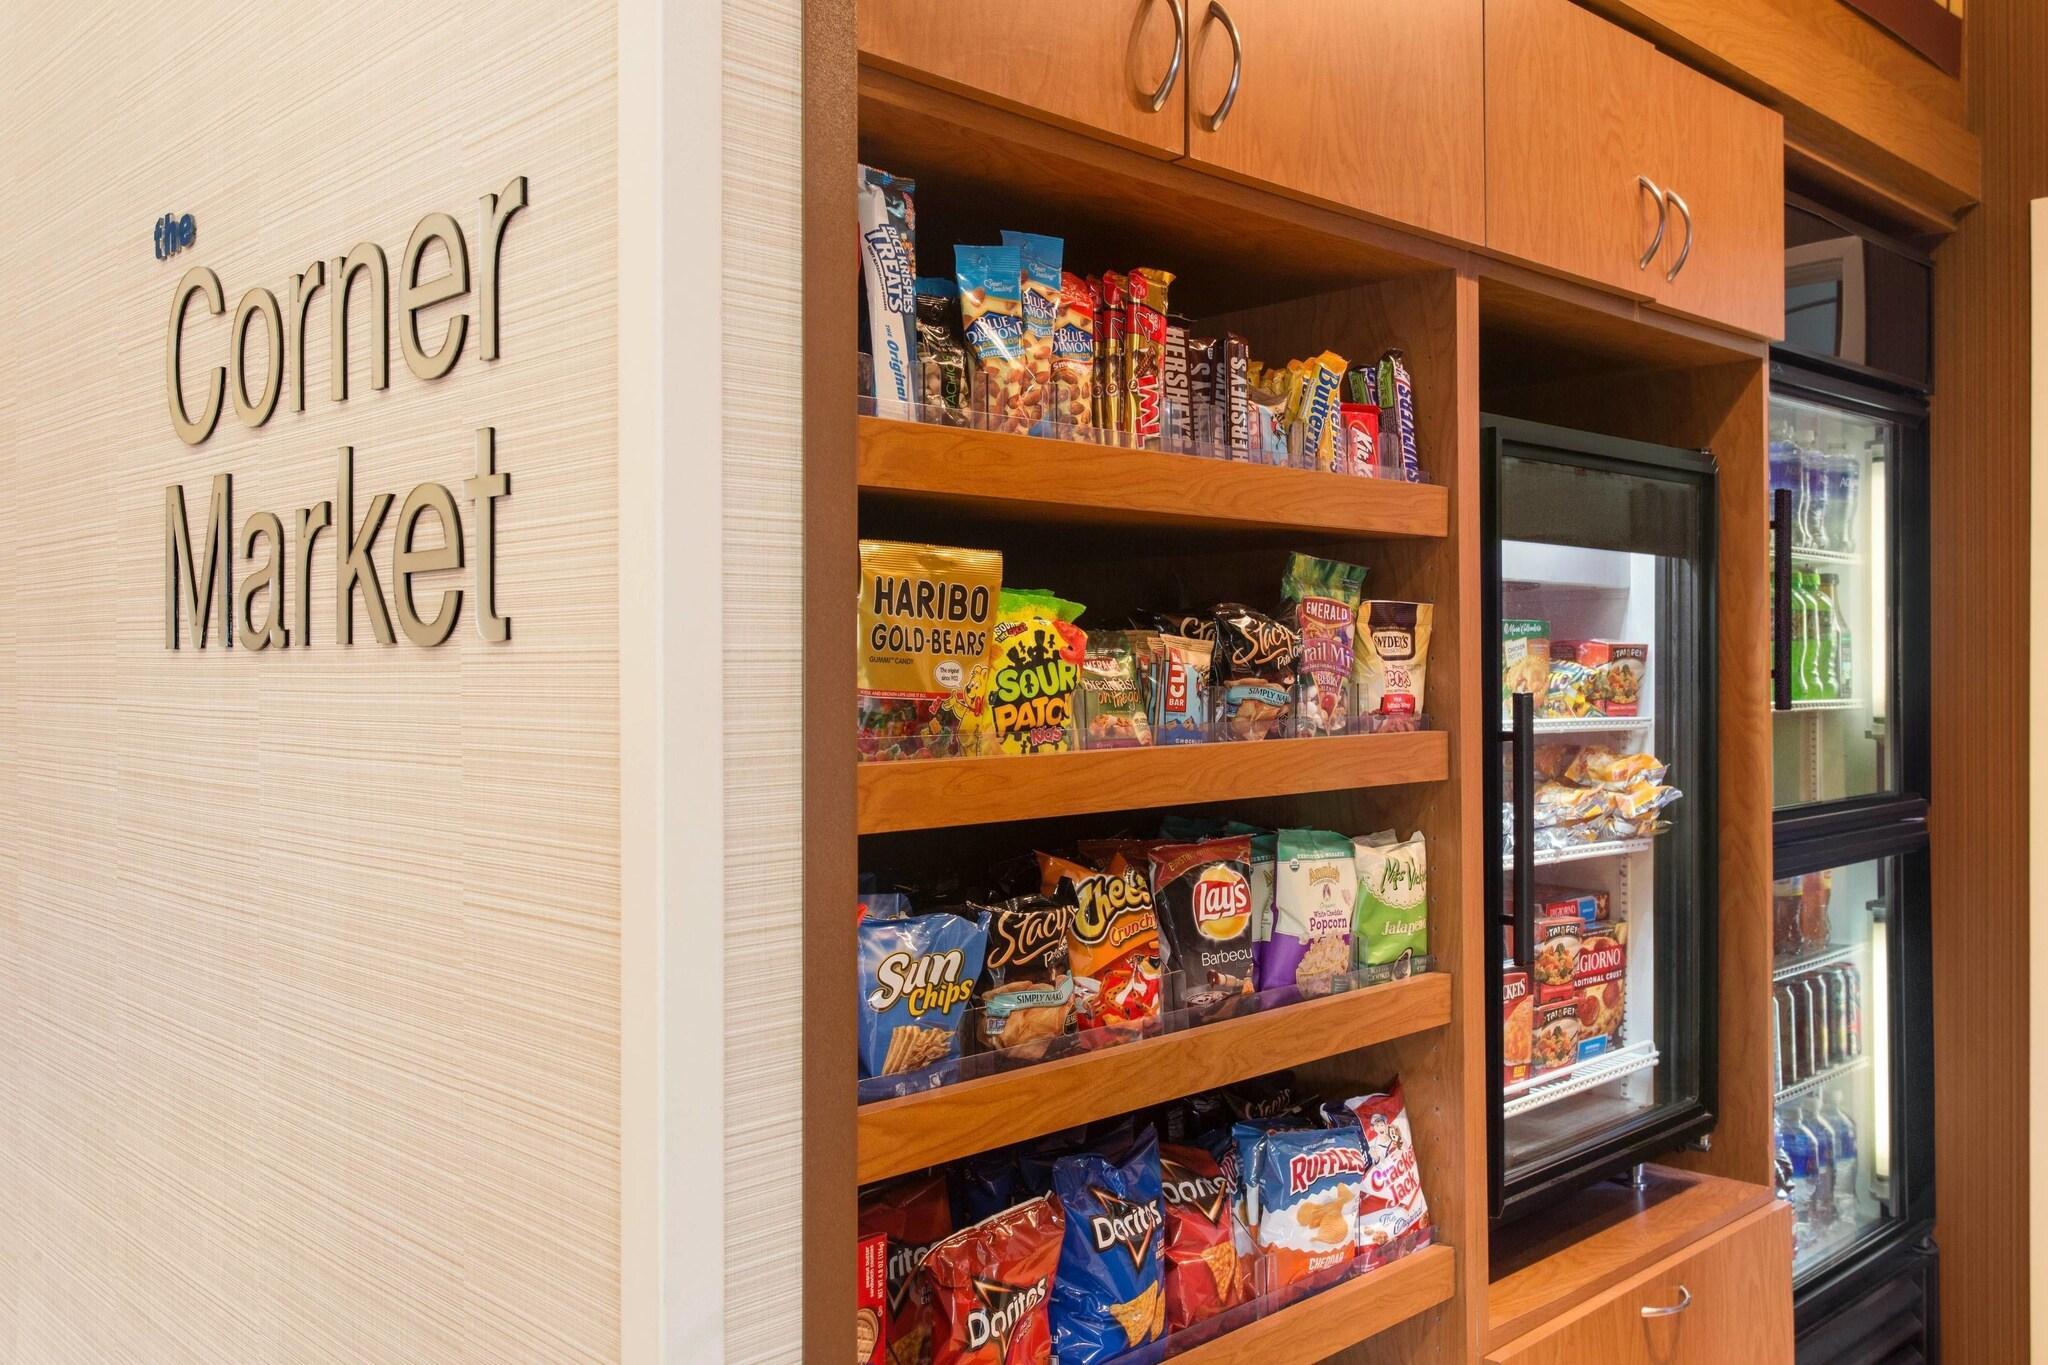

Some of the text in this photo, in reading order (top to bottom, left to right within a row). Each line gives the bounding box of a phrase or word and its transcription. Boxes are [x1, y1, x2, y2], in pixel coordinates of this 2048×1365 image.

[154, 212, 197, 261] the
[864, 224, 904, 313] TREATS
[886, 226, 904, 254] RICE
[895, 252, 914, 314] KRISPIES
[166, 176, 529, 446] Corner
[1023, 291, 1046, 310] BLUE
[1023, 303, 1058, 320] AMON
[966, 321, 1024, 345] DIAON
[1059, 328, 1086, 343] BLUE
[887, 341, 907, 402] Original
[1164, 326, 1194, 449] HERSHEY'S
[1230, 356, 1249, 463] HERSHEY'S
[165, 427, 512, 652] Market
[873, 576, 990, 624] HARIBO
[1306, 601, 1348, 621] EMERALD
[871, 623, 986, 657] GOLD-BEARS
[1232, 617, 1303, 665] Stacy
[1302, 642, 1326, 662] rail
[997, 659, 1077, 702] SOUR
[1169, 649, 1186, 698] CLIF
[1248, 687, 1290, 702] SIMPLY NAK
[1169, 698, 1185, 707] BAR
[1074, 874, 1151, 940] Chee
[1199, 880, 1248, 922] Lay's
[986, 905, 1078, 969] Stacy's
[1309, 917, 1348, 935] Popcorn
[1201, 949, 1253, 967] Barbecu
[1573, 970, 1622, 988] ADITIONAL CRUST
[868, 949, 965, 1012] Sun
[908, 979, 974, 1017] Chips
[1016, 993, 1045, 1004] SIMPLY
[1045, 993, 1064, 1002] NAK
[1503, 978, 1526, 1000] CKETS
[1290, 1147, 1367, 1197] RUFFLES
[1386, 1171, 1418, 1208] Jack
[1092, 1200, 1164, 1250] Doritos
[967, 1277, 1048, 1349] Doritos
